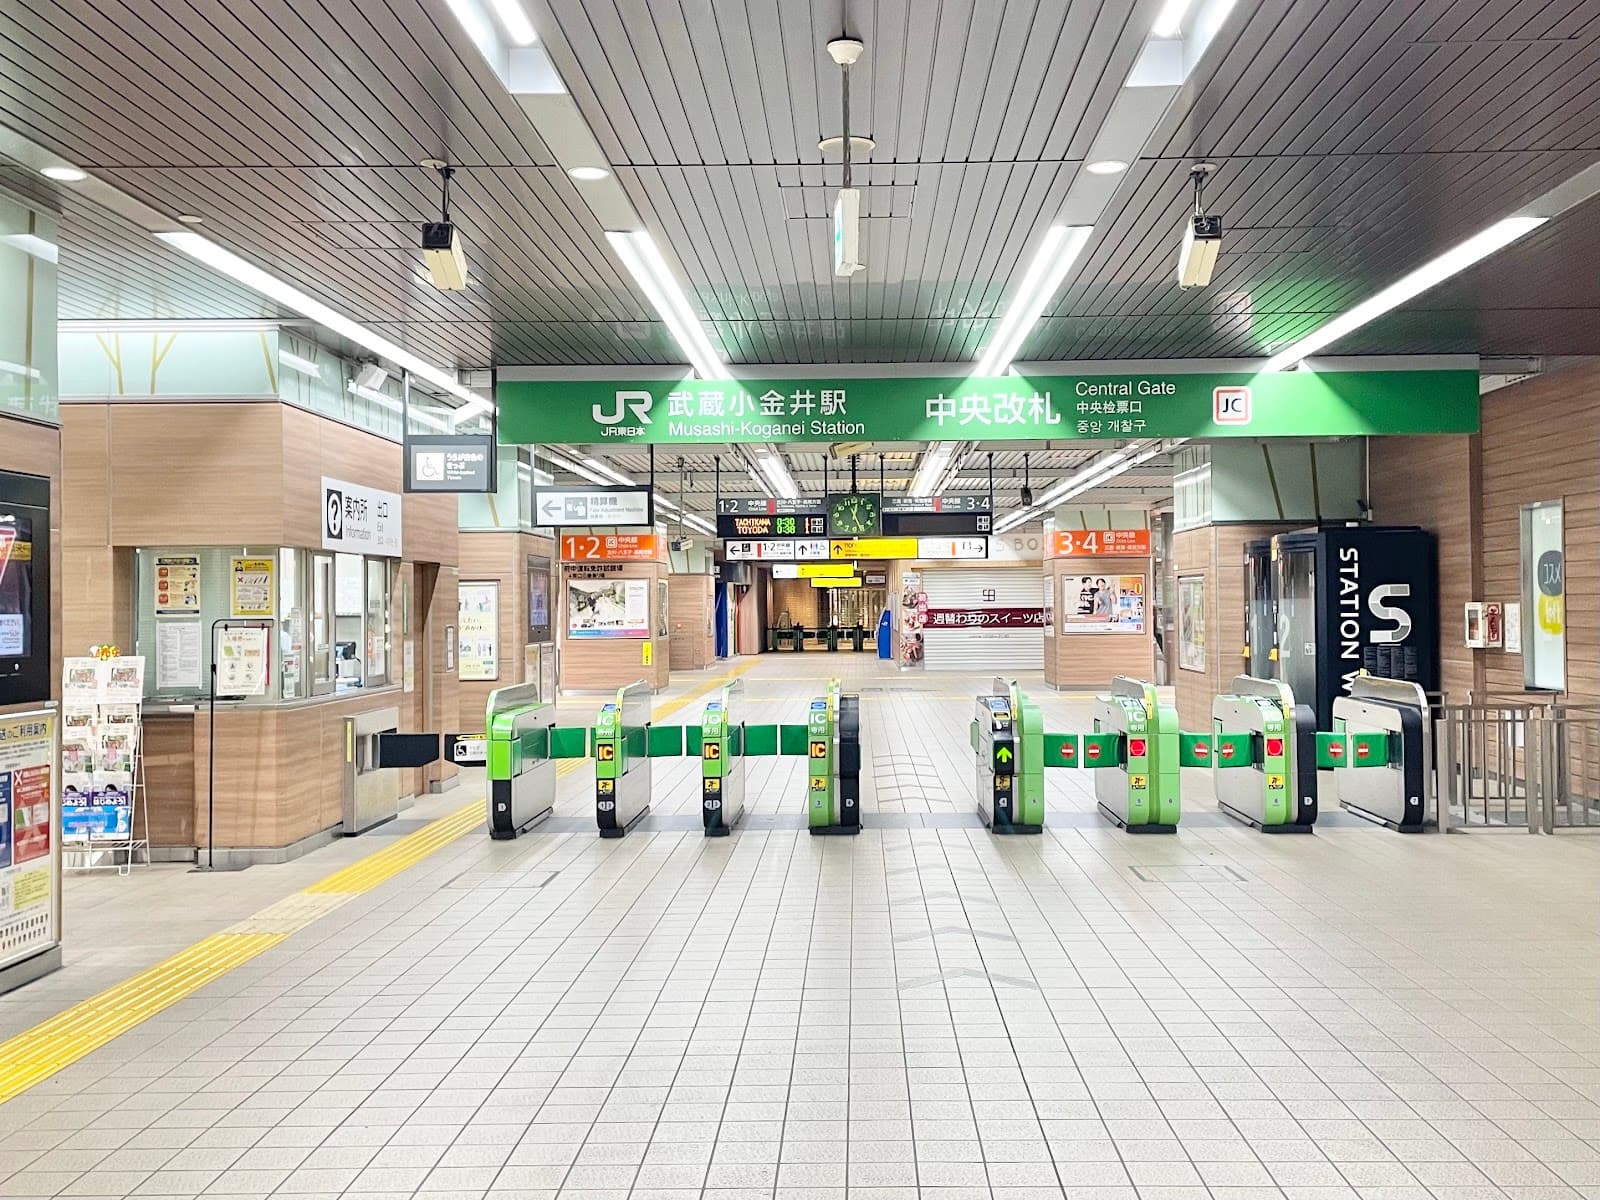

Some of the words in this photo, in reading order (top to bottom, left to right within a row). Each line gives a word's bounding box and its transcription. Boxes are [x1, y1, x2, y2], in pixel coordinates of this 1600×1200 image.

[1075, 380, 1131, 396] Central
[1138, 380, 1177, 396] Gate
[592, 391, 654, 425] JR
[668, 390, 848, 418] 武蔵小金井駅
[924, 391, 1062, 426] 中央改札
[1221, 396, 1243, 414] JC
[601, 426, 646, 437] JR東日本
[668, 420, 806, 439] Musashi-Koganei
[811, 420, 866, 437] Station
[1076, 418, 1103, 434] 중앙
[1107, 418, 1147, 433] 개찰구
[344, 496, 368, 523] 案内所
[377, 499, 389, 519] 出口
[735, 518, 771, 526] TACHIKAWA
[737, 526, 769, 534] TOYODA
[1339, 547, 1361, 660] STATION
[810, 713, 826, 724] IC
[1127, 711, 1145, 722] IC
[598, 745, 614, 761] IC
[705, 744, 720, 759] IC
[811, 743, 826, 758] IC
